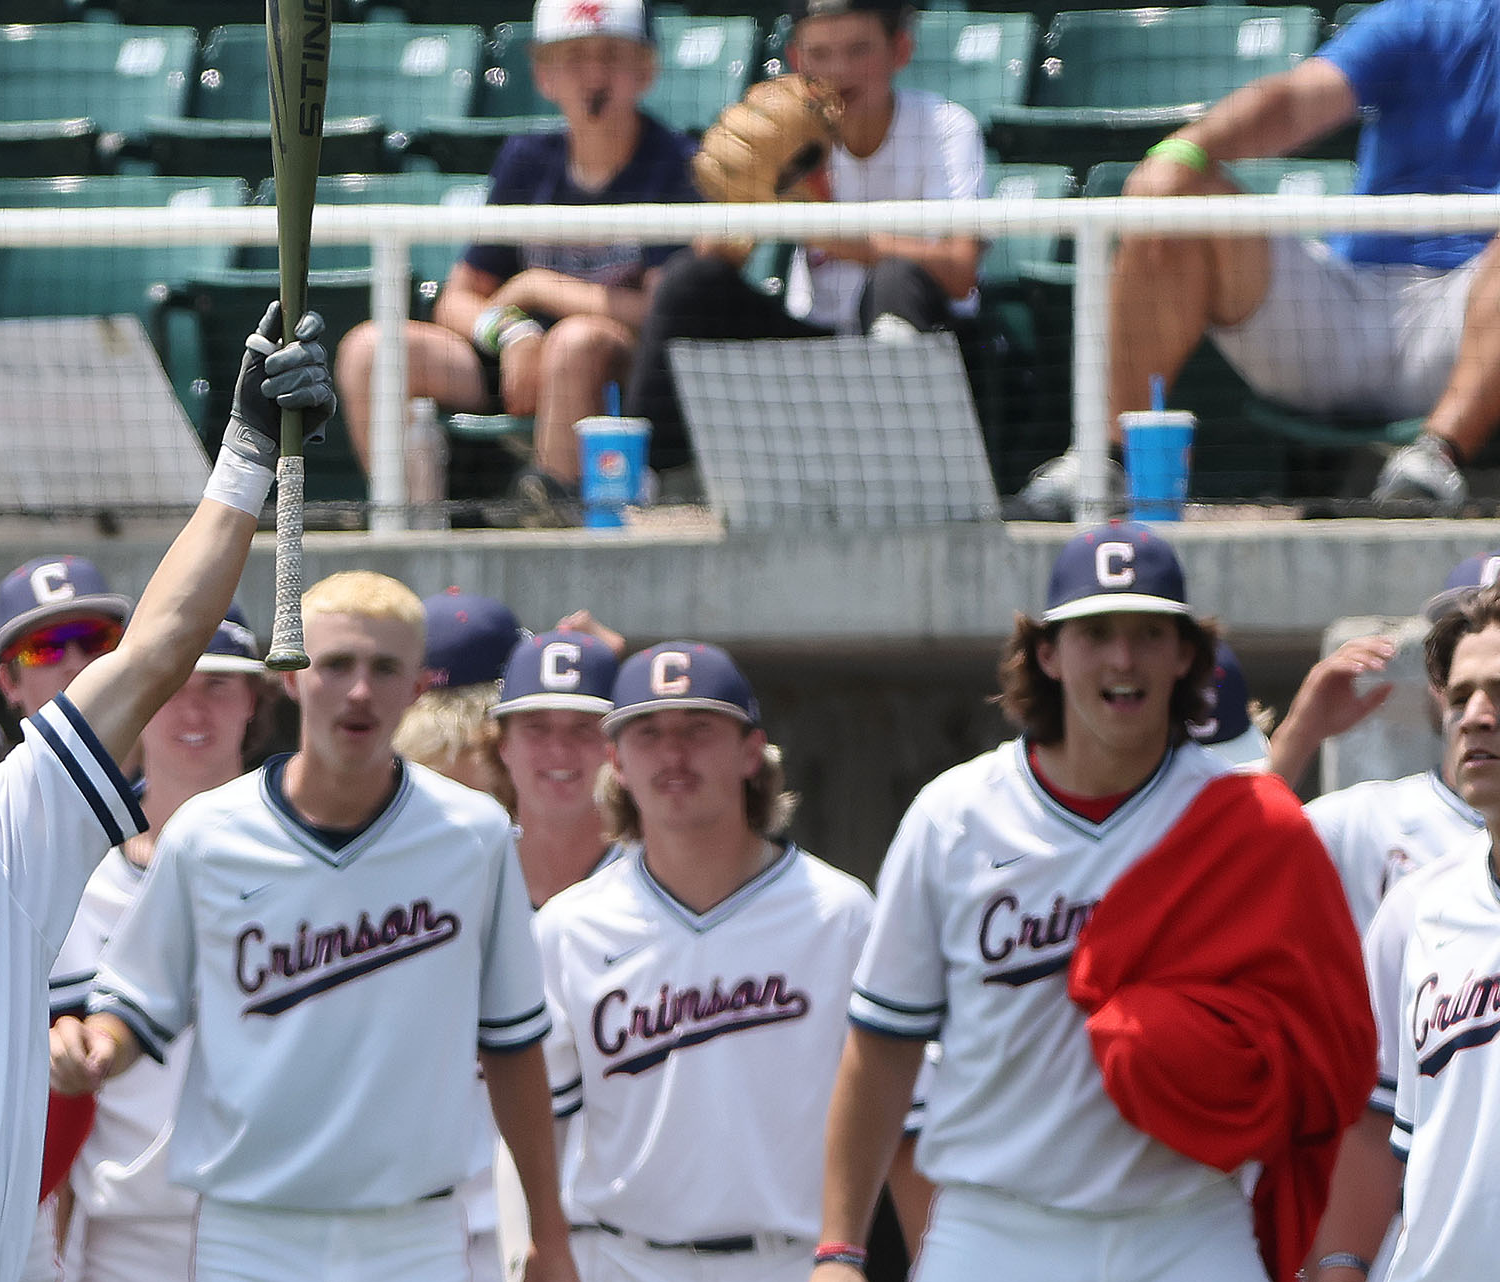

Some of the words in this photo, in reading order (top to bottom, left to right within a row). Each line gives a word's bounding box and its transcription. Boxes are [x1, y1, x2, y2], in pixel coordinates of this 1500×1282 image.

[30, 562, 76, 605] C
[1095, 541, 1136, 589] C
[541, 642, 581, 691] C
[652, 651, 691, 696] C
[235, 898, 462, 993] Crimson
[979, 890, 1102, 962] Crim
[592, 974, 811, 1056] Crimson
[1412, 970, 1500, 1052] Crim
